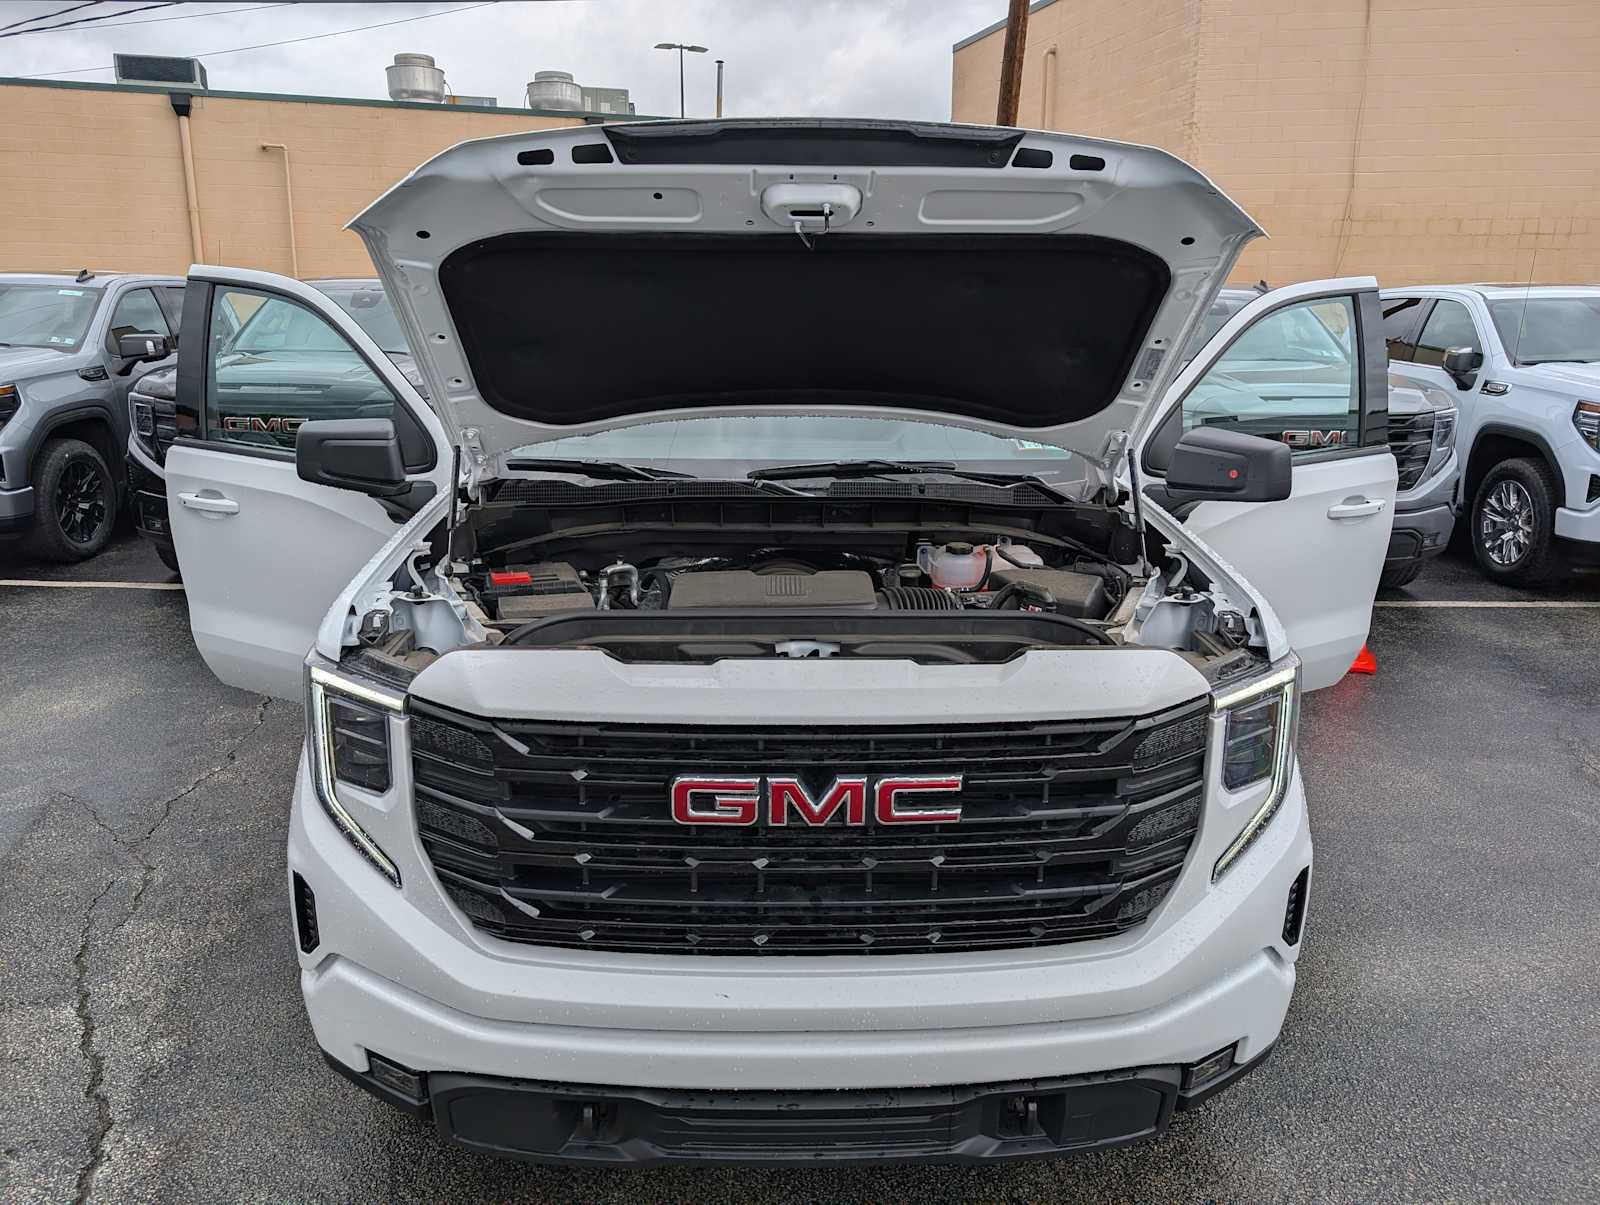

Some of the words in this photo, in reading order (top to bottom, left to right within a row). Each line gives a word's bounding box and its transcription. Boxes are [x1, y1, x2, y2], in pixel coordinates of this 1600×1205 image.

[223, 416, 309, 433] GMC
[1282, 430, 1348, 447] GM
[671, 774, 963, 826] GMC
